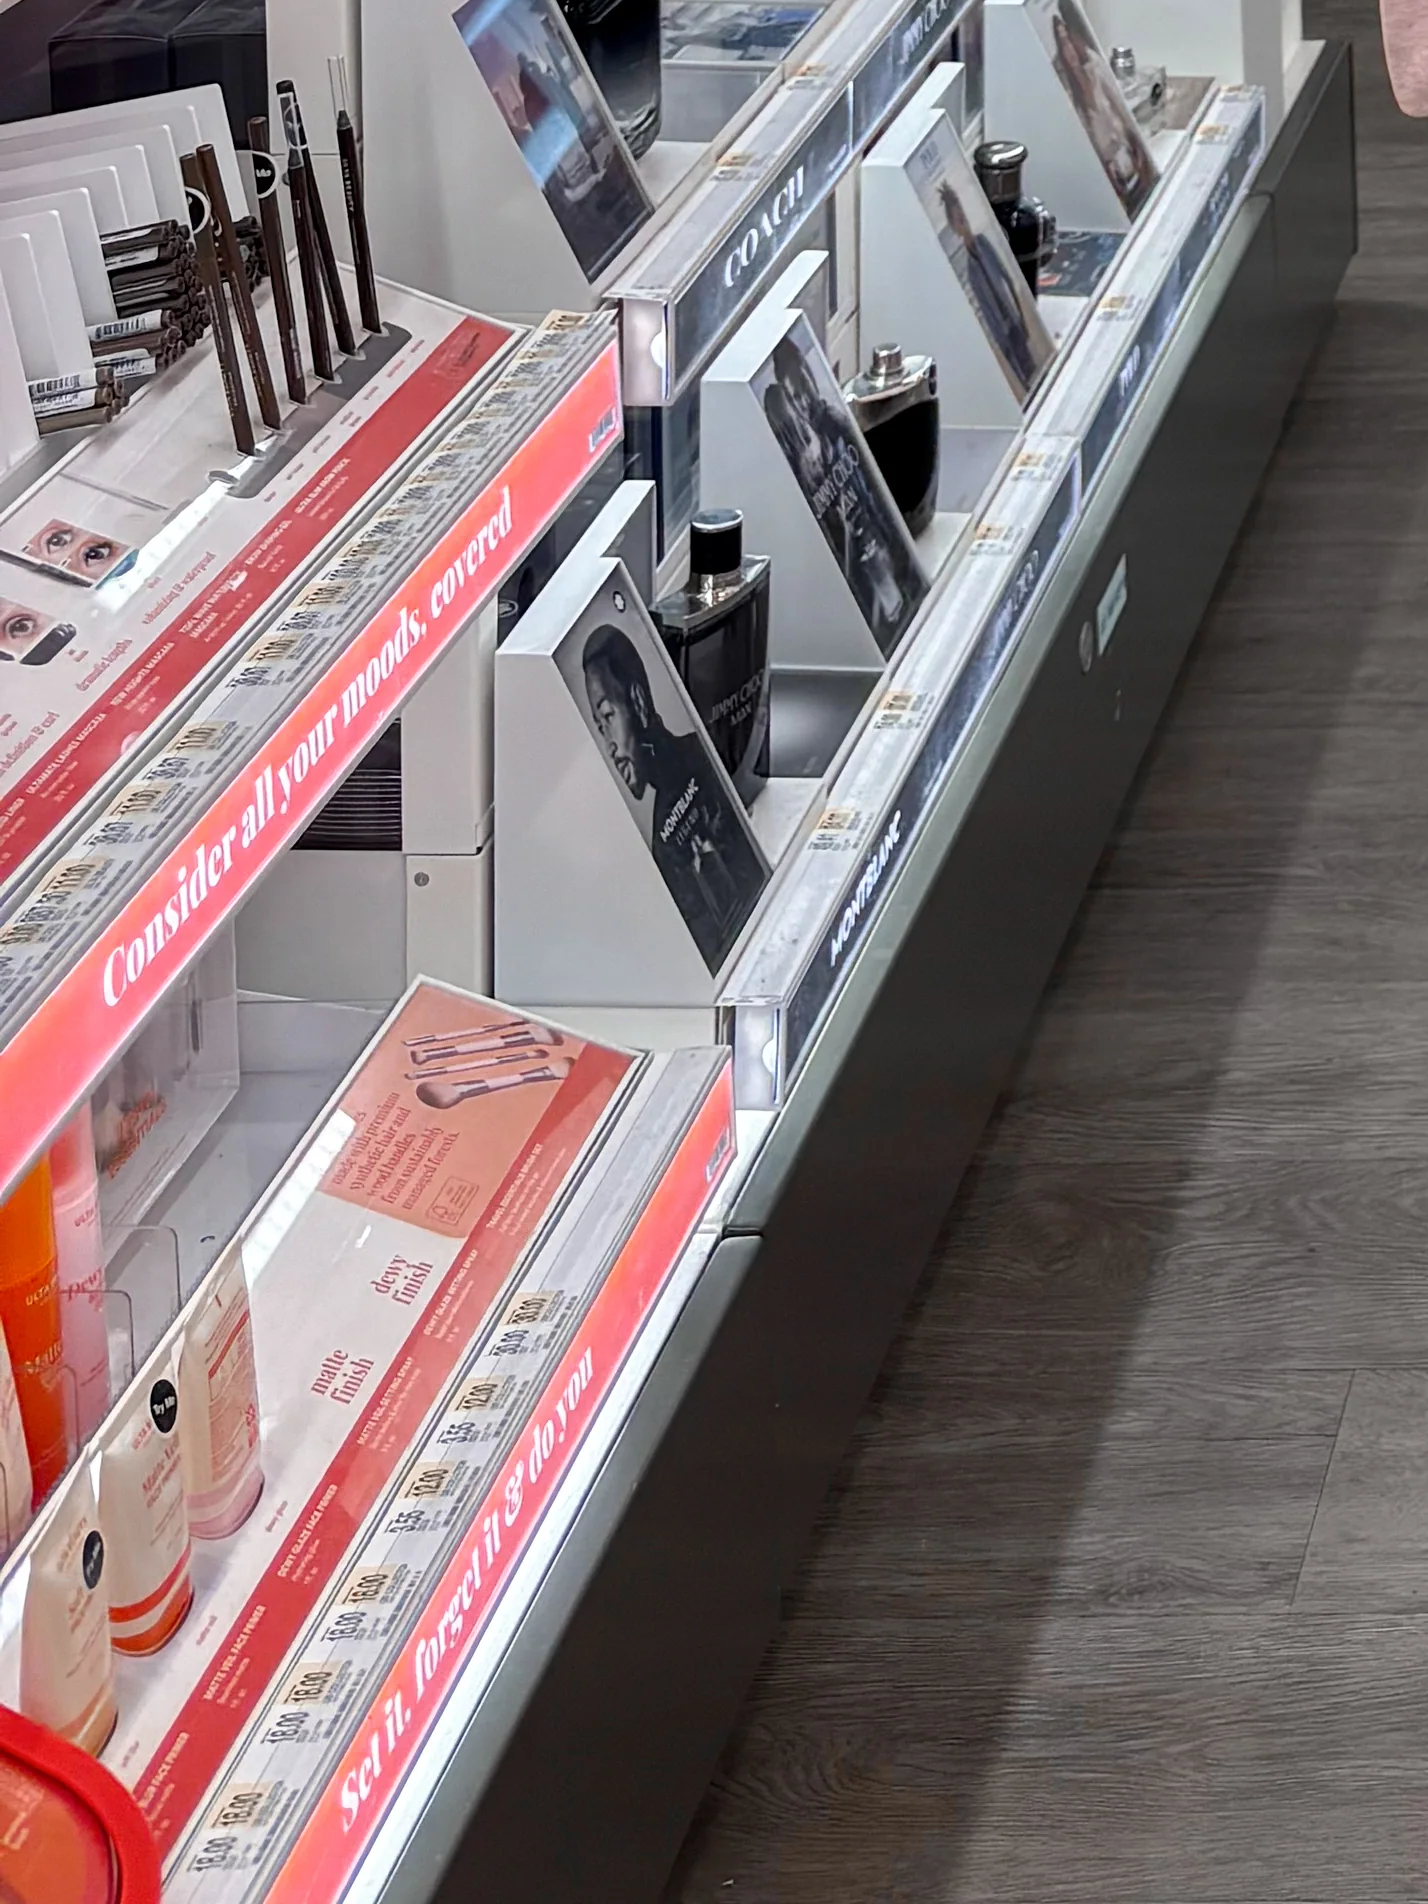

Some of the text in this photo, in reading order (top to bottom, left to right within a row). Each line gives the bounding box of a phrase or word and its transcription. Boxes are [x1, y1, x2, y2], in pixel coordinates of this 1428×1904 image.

[724, 165, 804, 288] COACH
[102, 818, 238, 1007] Consider
[240, 769, 277, 850] all
[277, 706, 340, 814] your
[340, 610, 428, 722] moods,
[430, 485, 514, 620] covered
[660, 778, 699, 842] MONTBLANC
[831, 810, 902, 968] MONTBLANC
[383, 1128, 417, 1173] handles
[370, 1254, 408, 1295] dewy
[392, 1261, 433, 1305] finish
[311, 1348, 348, 1396] matte
[330, 1356, 374, 1404] finish
[153, 1401, 165, 1415] Try
[461, 1382, 498, 1411] 12.00
[411, 1467, 449, 1498] 12.00
[341, 1346, 593, 1833] Set it, forget it & do you
[350, 1572, 389, 1604] 18.00
[327, 1610, 368, 1642] 18.00
[293, 1670, 333, 1704] 18.00
[265, 1710, 311, 1744] 18.00
[219, 1791, 264, 1826] 18.00
[193, 1835, 239, 1872] 18.00
